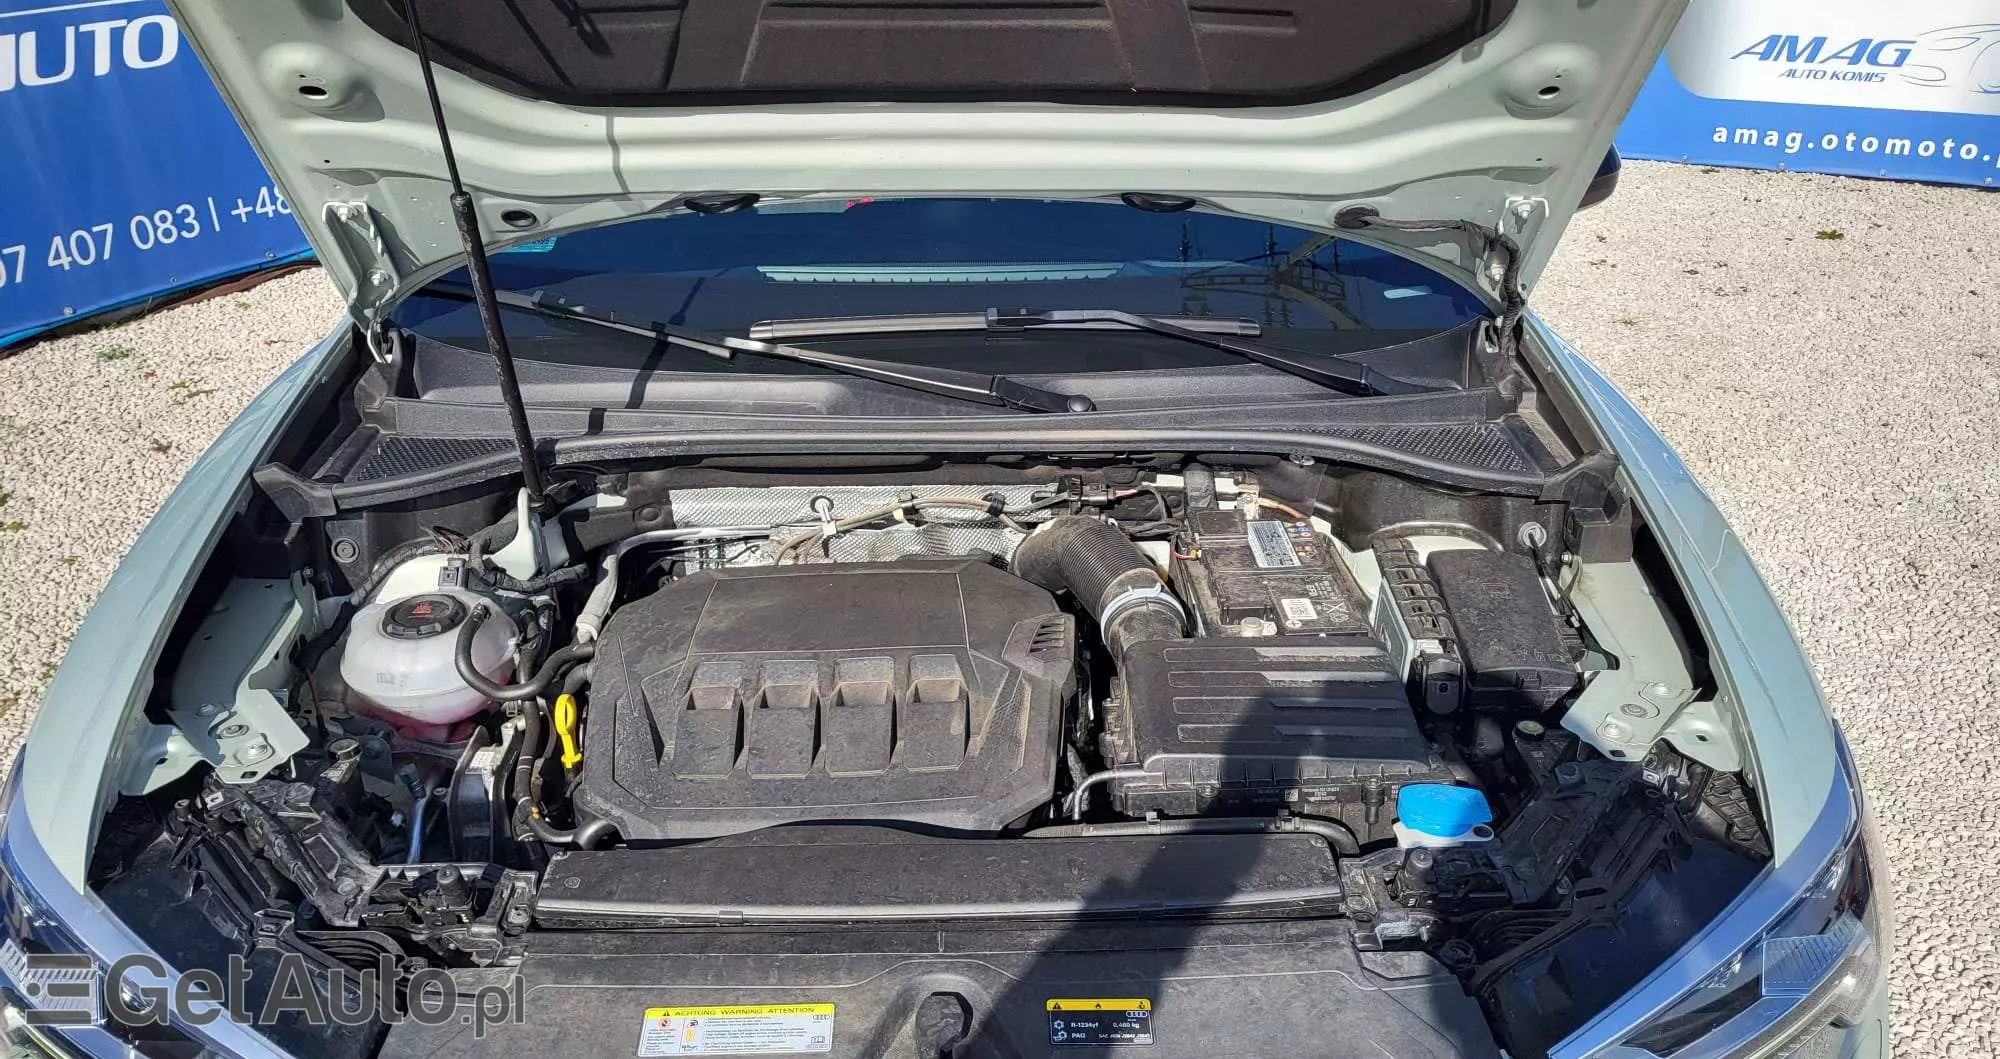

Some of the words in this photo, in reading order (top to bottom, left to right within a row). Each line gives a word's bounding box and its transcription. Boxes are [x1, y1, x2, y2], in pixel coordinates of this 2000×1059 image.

[0, 14, 179, 92] UTO
[1778, 68, 1826, 80] AUTO
[1829, 70, 1888, 83] KOMIS
[1713, 126, 2000, 168] amag.otomoto.
[0, 244, 26, 288] 7
[47, 222, 114, 271] 407
[130, 203, 200, 250] 083
